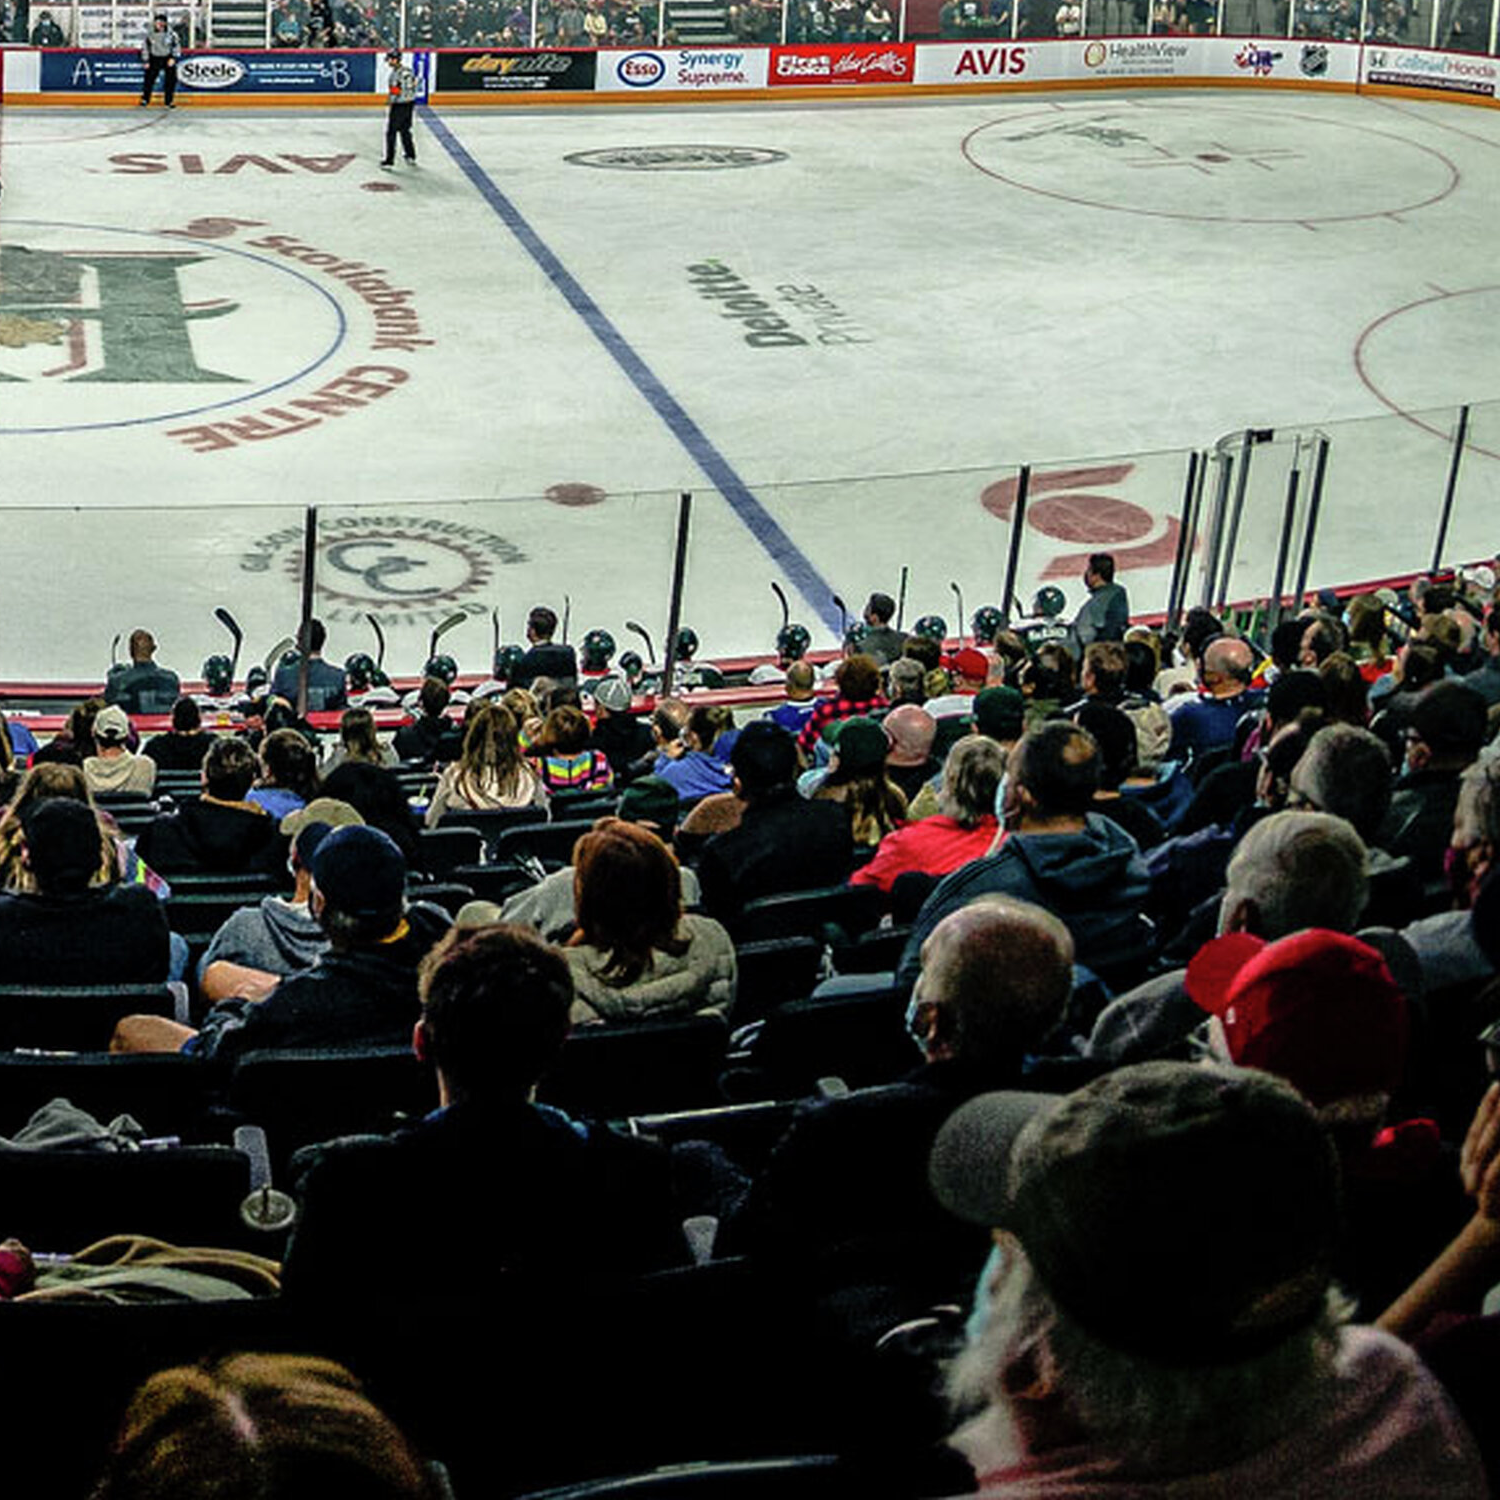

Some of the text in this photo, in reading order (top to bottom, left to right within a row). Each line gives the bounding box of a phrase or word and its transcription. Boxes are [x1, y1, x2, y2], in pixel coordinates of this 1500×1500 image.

[182, 63, 237, 78] Steele
[624, 60, 659, 77] Esso
[677, 51, 745, 71] Synergy
[954, 47, 1026, 76] AVIS
[1447, 60, 1497, 78] Honda
[107, 152, 357, 176] AVIS
[686, 263, 810, 348] Deloitte
[165, 364, 411, 453] CENTRE
